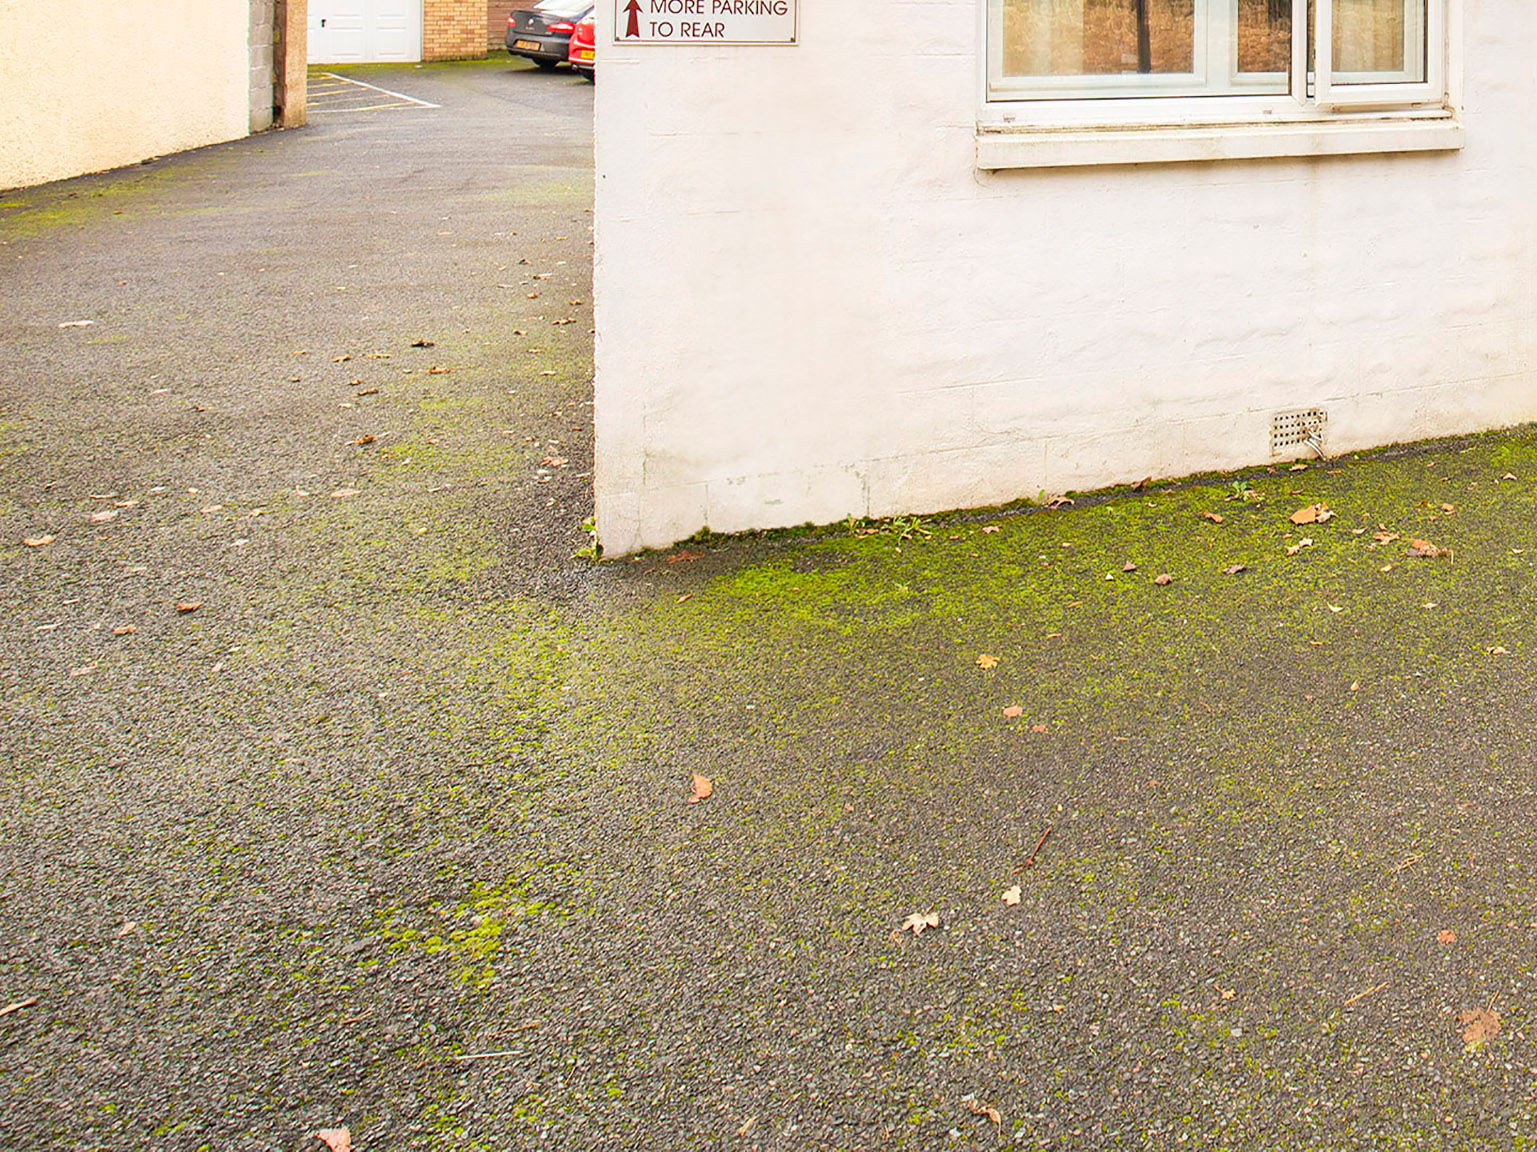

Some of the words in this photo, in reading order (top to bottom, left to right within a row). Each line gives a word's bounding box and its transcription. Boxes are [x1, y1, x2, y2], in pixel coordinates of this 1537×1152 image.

[712, 0, 788, 16] PARKING
[650, 21, 674, 37] TO
[680, 22, 725, 38] REAR
